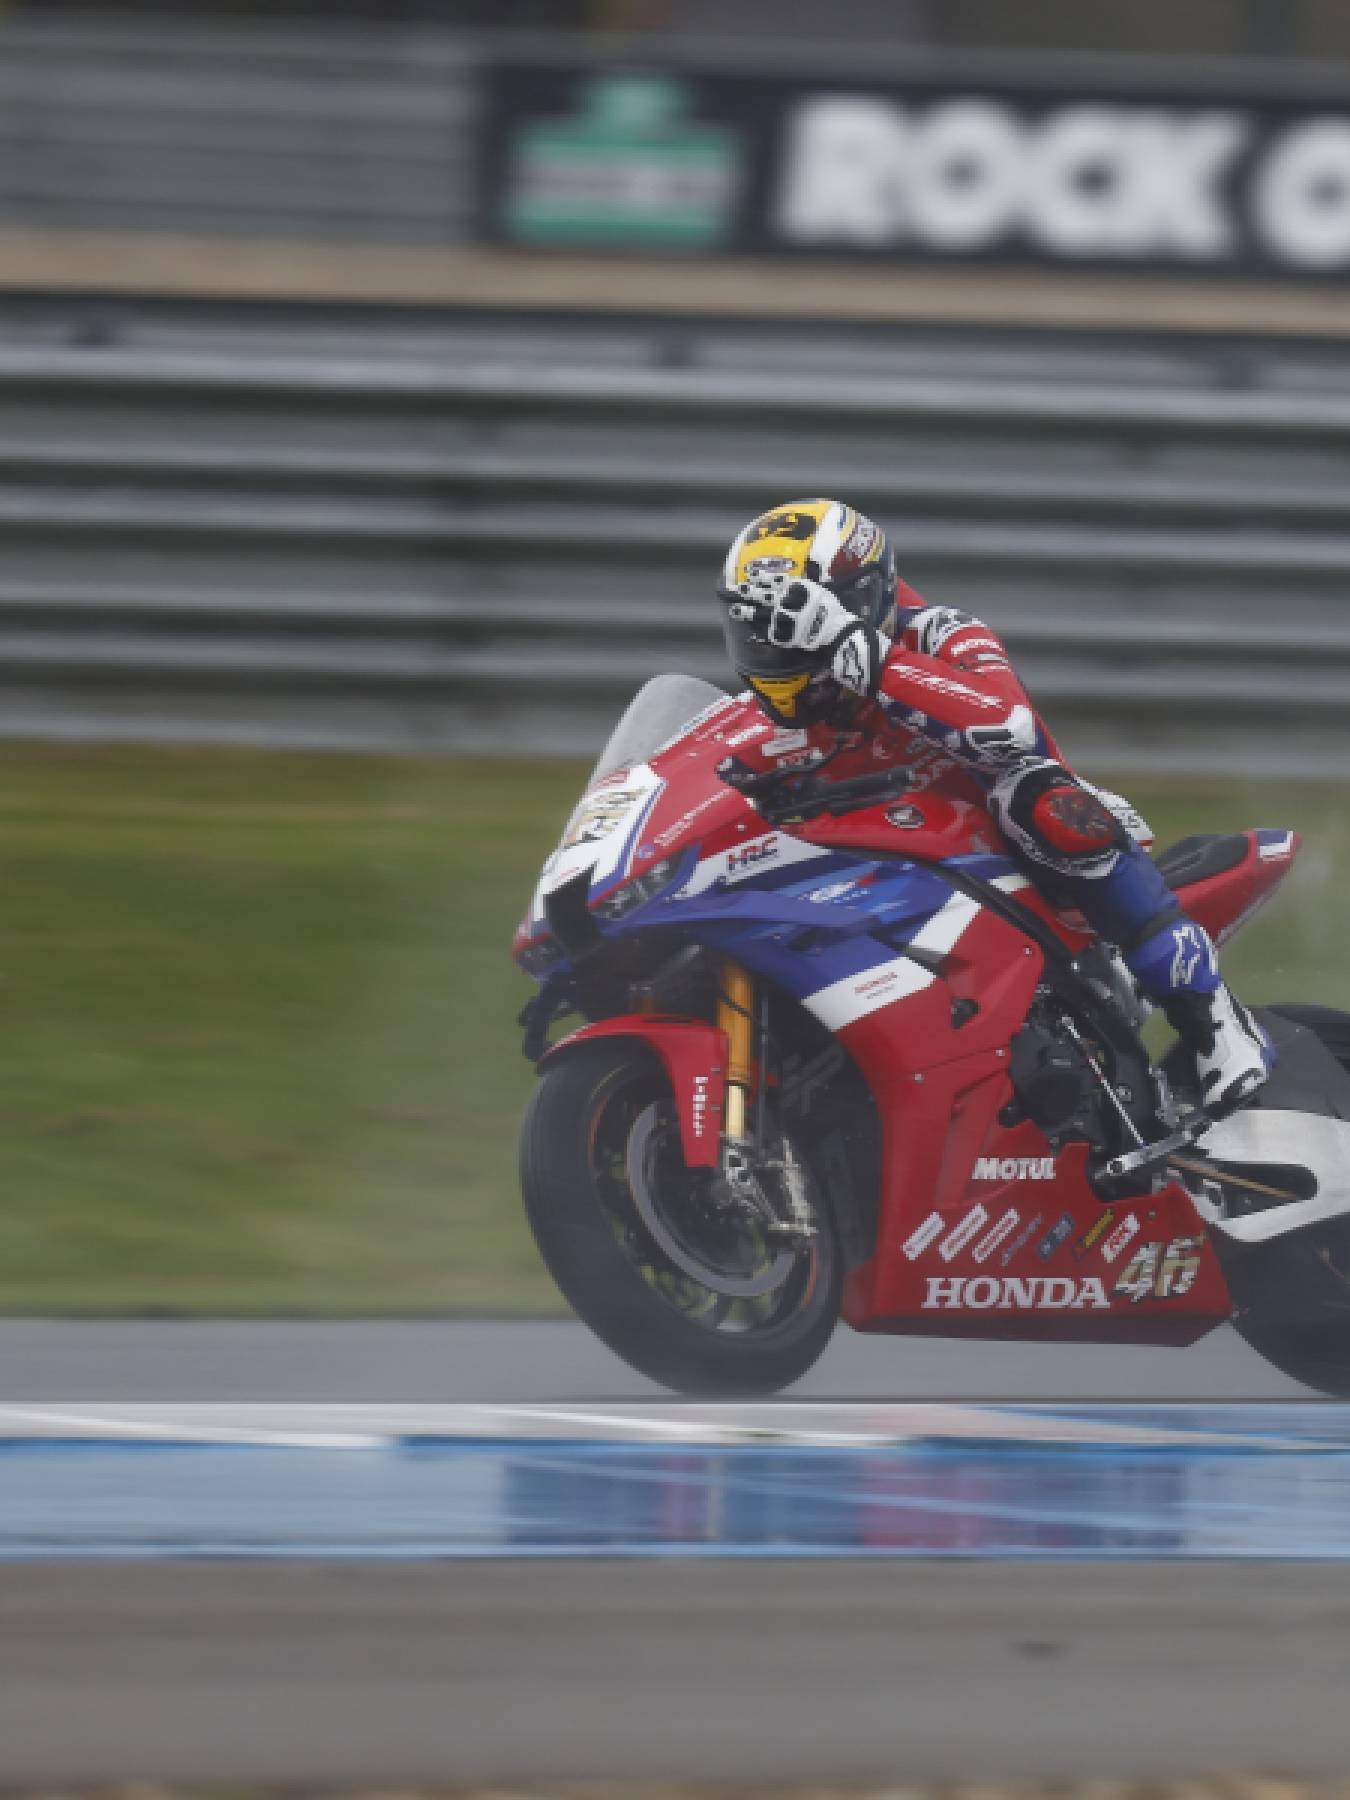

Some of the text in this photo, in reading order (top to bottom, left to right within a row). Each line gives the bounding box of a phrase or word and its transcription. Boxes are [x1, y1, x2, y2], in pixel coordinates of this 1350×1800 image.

[784, 97, 1238, 257] ROCK
[971, 1157, 1057, 1180] MOTUL
[921, 1276, 1111, 1309] HONDA
[1112, 1236, 1204, 1302] 46
